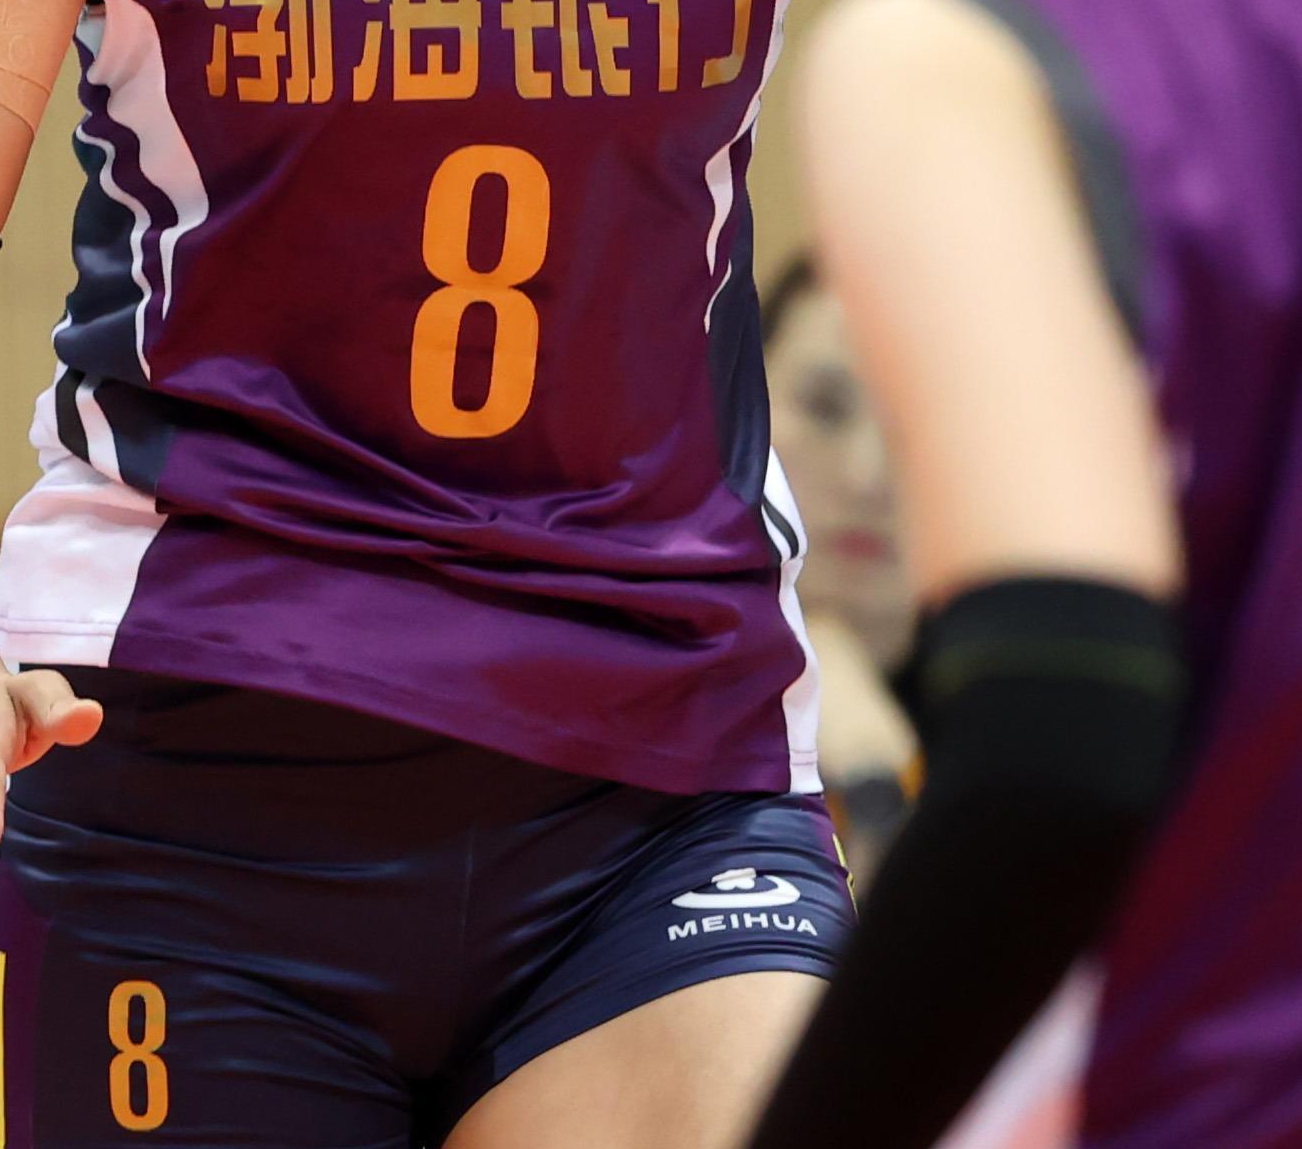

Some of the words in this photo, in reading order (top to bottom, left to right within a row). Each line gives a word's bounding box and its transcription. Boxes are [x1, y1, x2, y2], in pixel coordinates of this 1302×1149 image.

[409, 144, 551, 439] 8
[666, 911, 819, 941] MEIHUA
[107, 979, 169, 1132] 8
